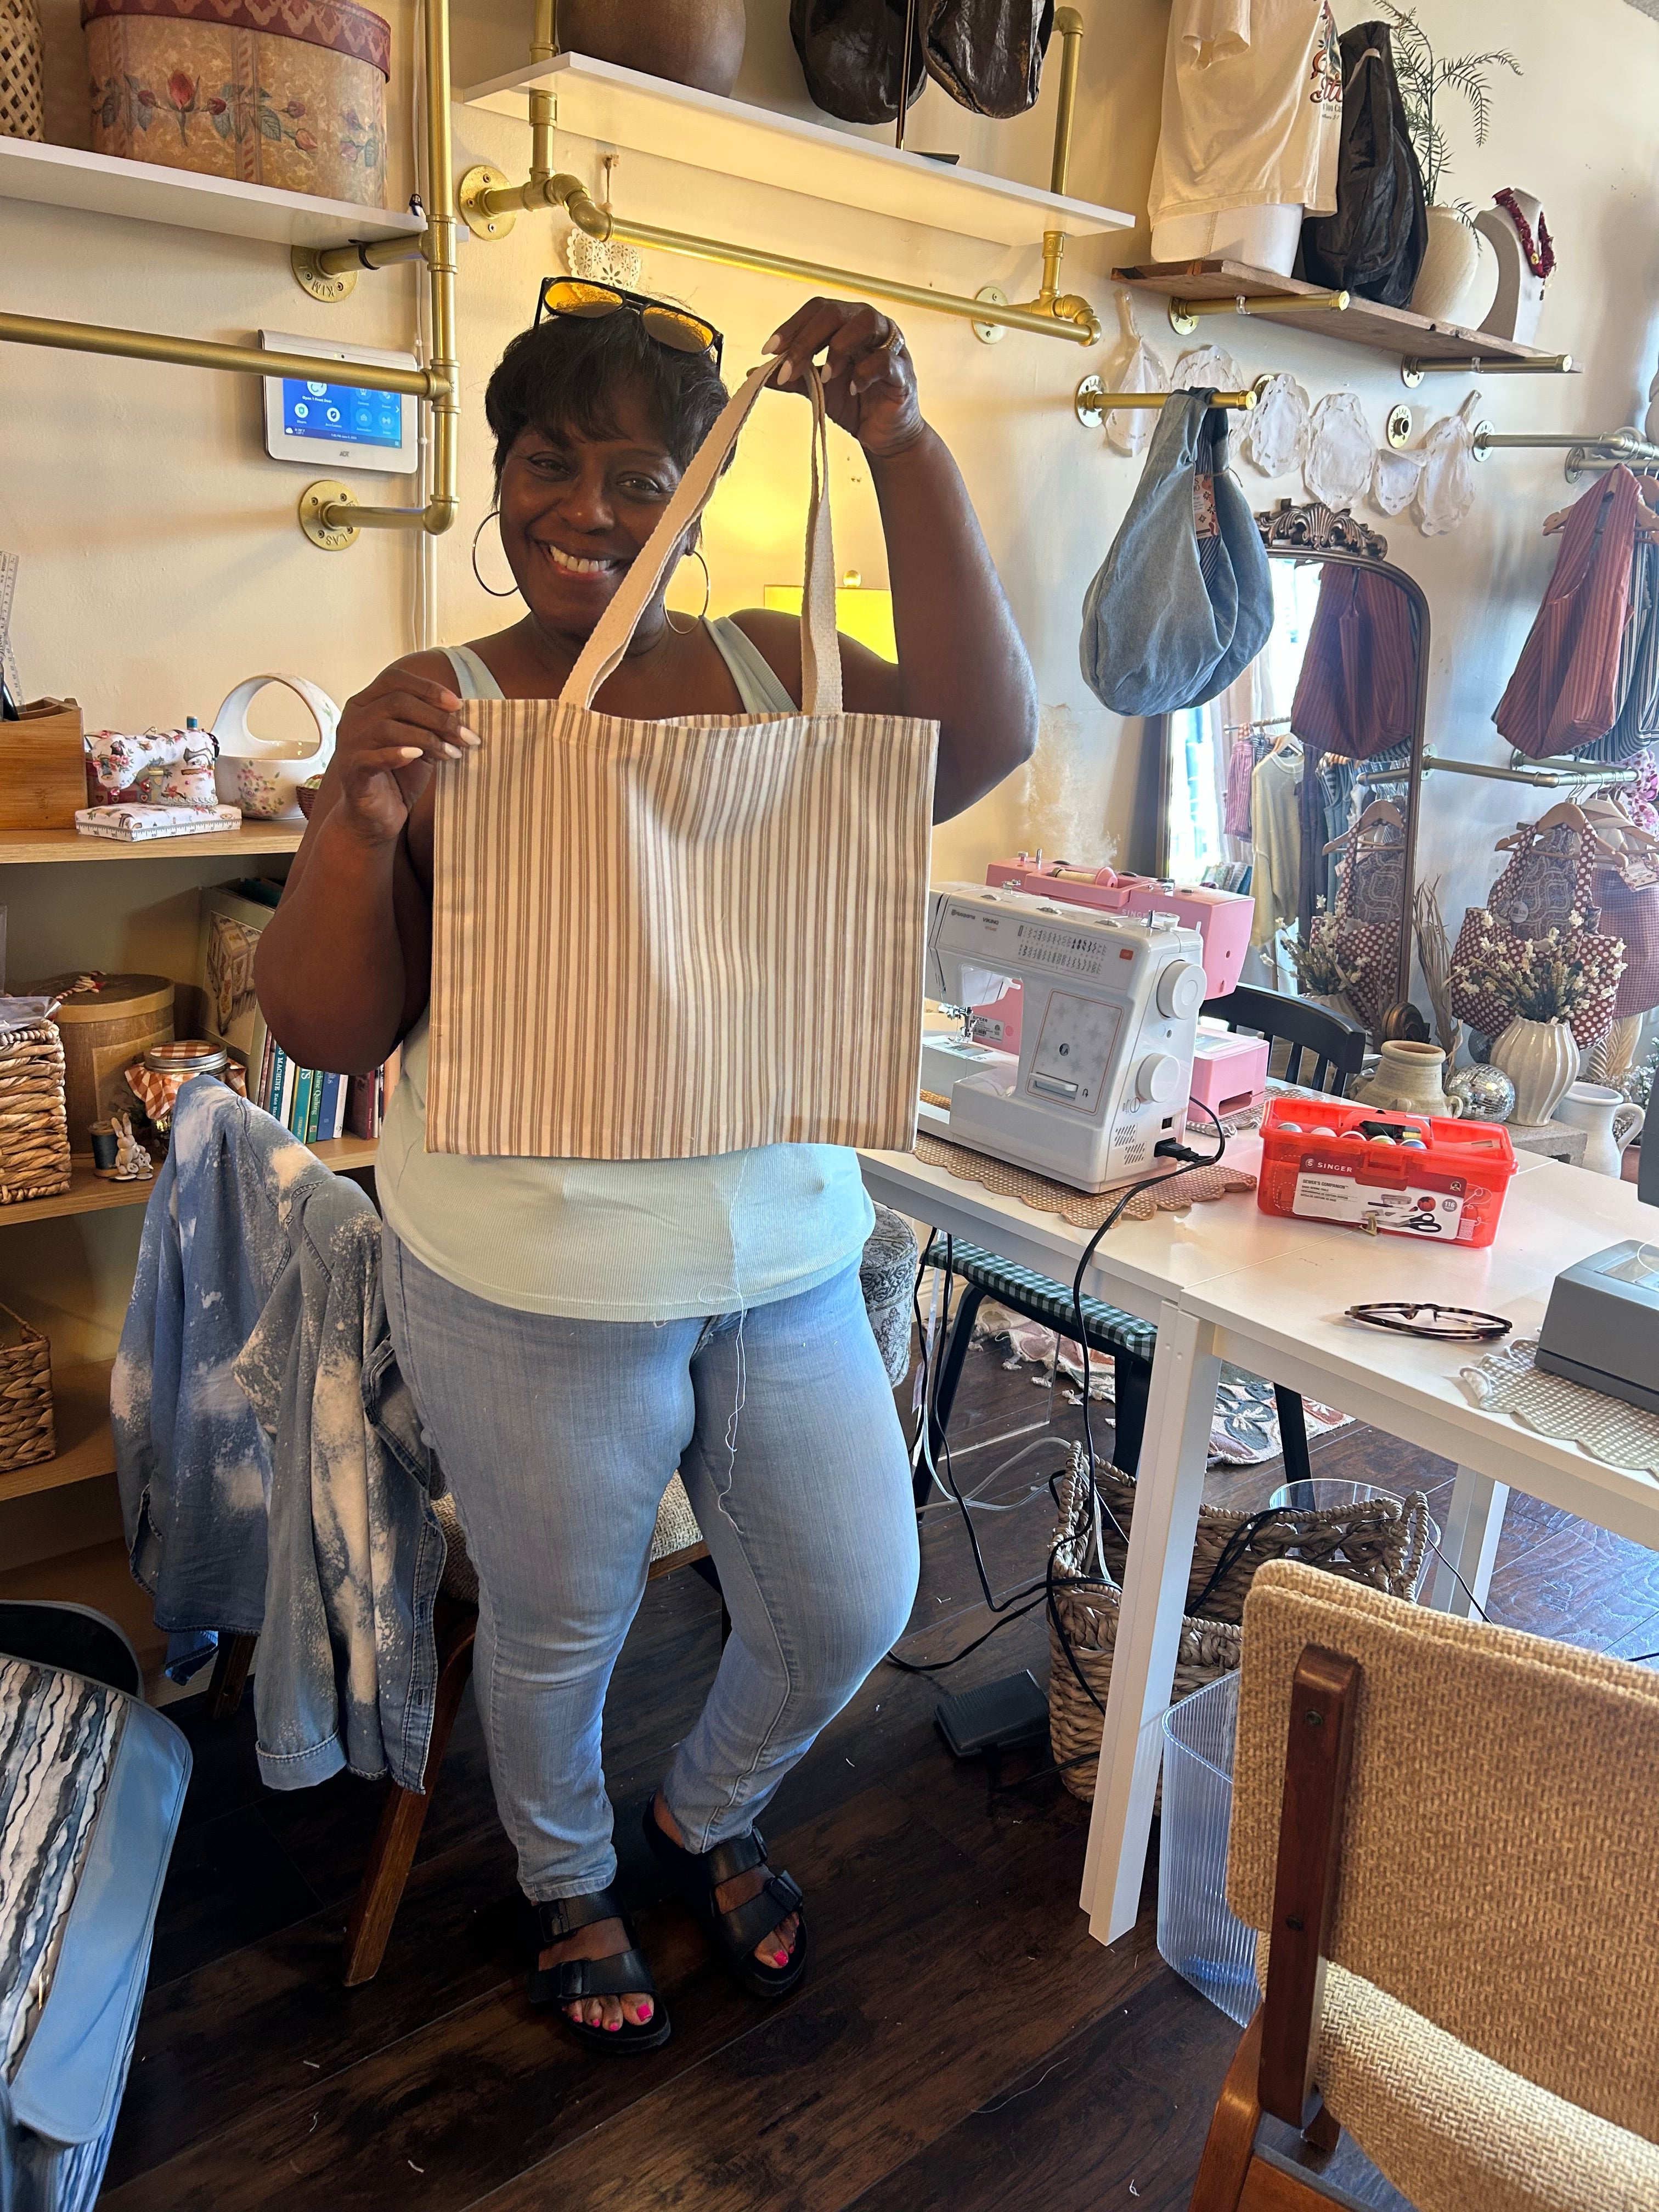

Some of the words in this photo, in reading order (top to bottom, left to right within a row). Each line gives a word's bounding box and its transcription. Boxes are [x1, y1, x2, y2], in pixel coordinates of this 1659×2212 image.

[1121, 909, 1149, 918] SINGE
[983, 917, 1000, 925] VIKING
[274, 1057, 284, 1091] MACHINE
[311, 1090, 321, 1115] Quilting
[1317, 1162, 1353, 1173] SINGER
